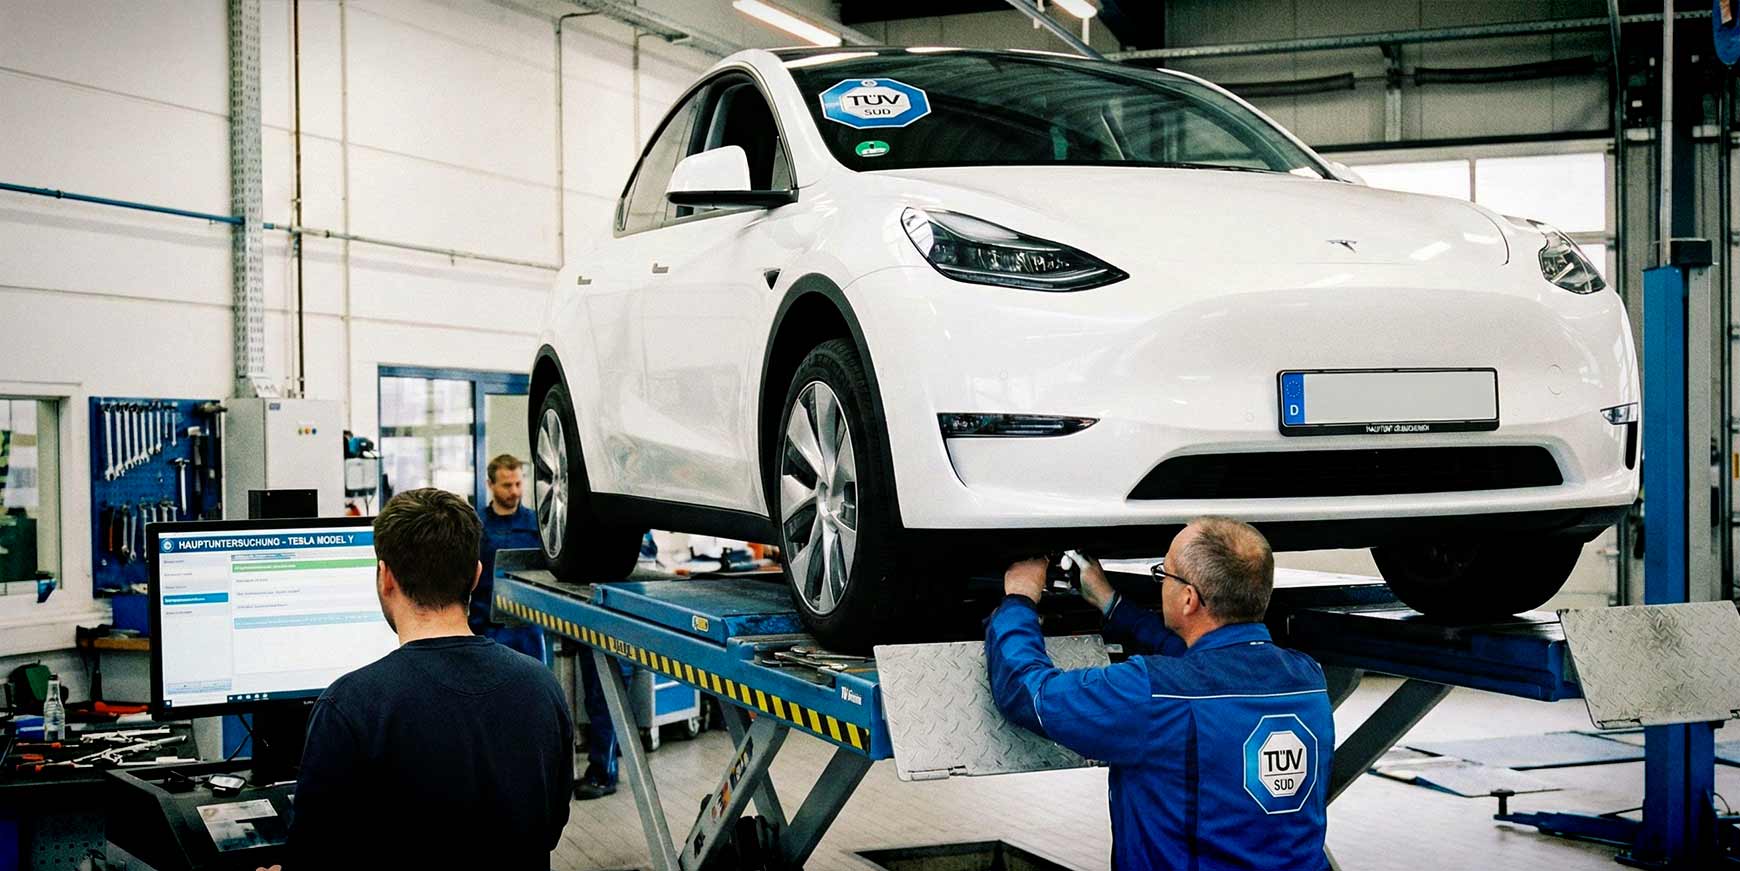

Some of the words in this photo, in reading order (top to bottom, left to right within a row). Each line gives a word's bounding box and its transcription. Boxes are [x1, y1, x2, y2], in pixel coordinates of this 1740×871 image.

[847, 95, 900, 106] TÜV
[1290, 404, 1299, 416] D
[288, 537, 315, 545] TESLA
[316, 535, 346, 545] MODEL
[347, 534, 354, 544] Y
[1263, 748, 1303, 772] TÜV
